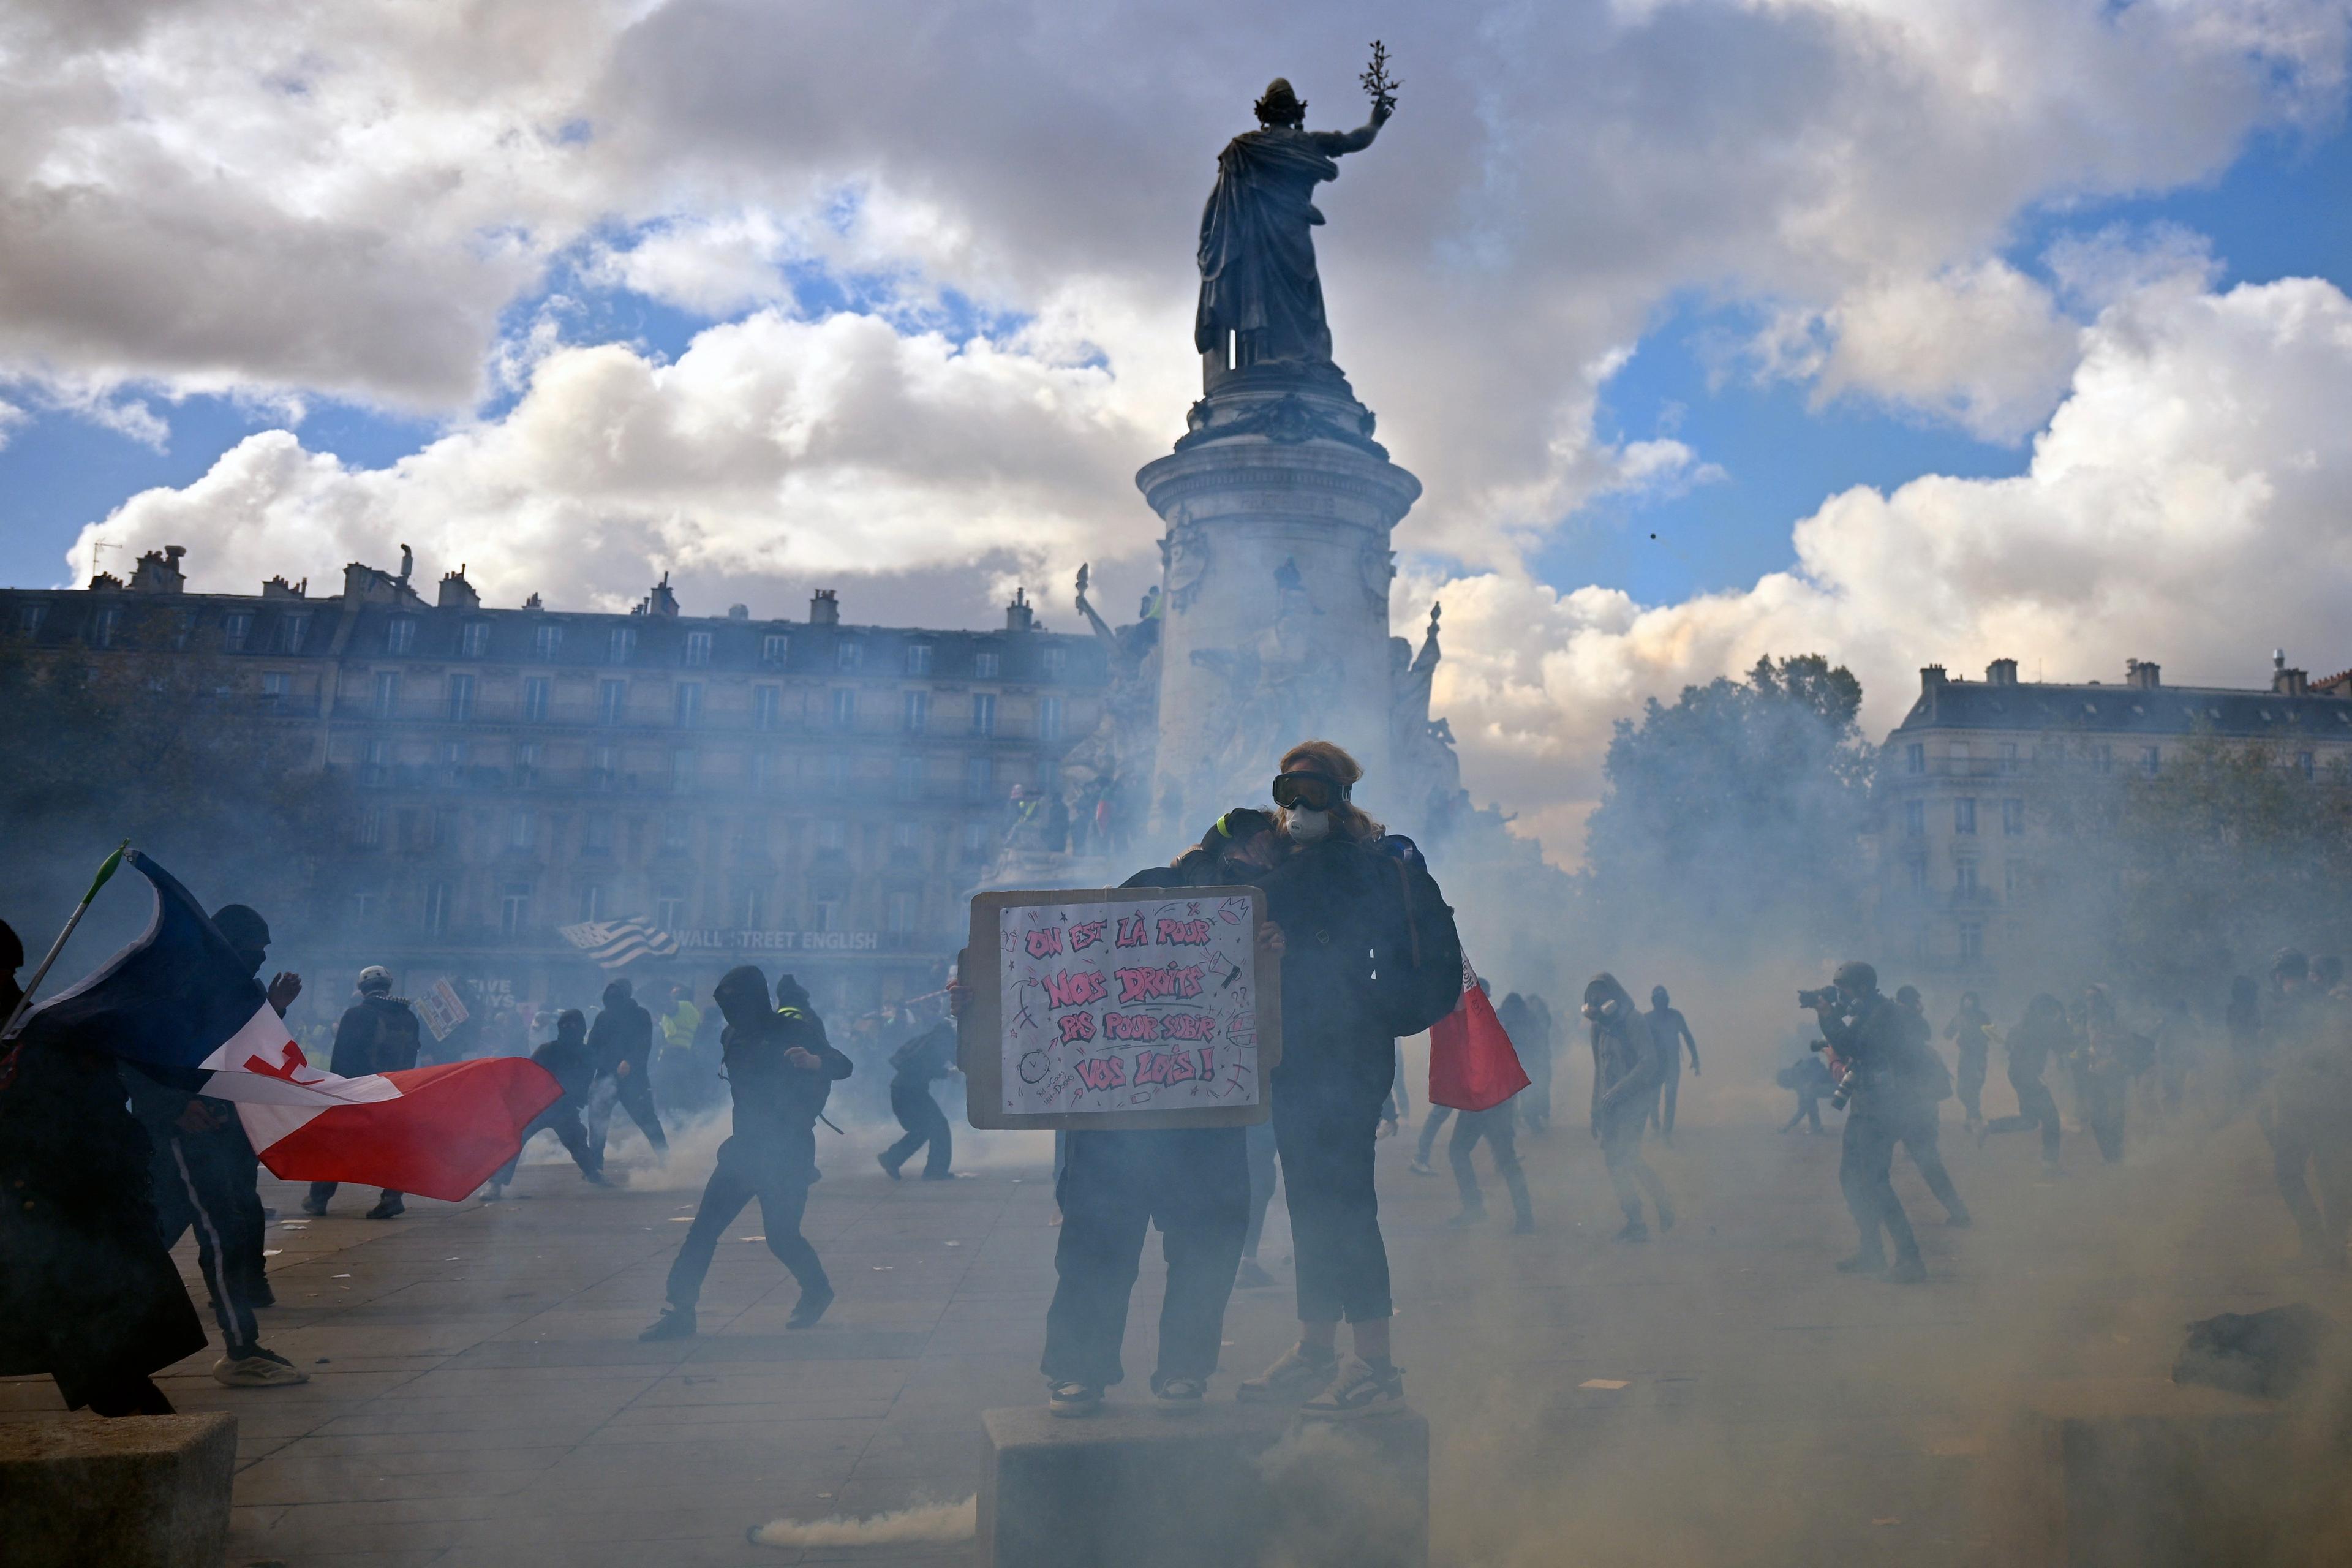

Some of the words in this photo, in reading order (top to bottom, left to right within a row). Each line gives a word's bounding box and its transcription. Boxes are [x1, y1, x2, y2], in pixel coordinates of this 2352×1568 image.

[674, 930, 723, 946] WALL
[802, 932, 878, 949] ENGLISH
[1025, 927, 1063, 960] ON
[1069, 919, 1107, 952] EST
[1115, 910, 1148, 949] LÀ
[1156, 918, 1211, 946] POUR
[1041, 968, 1108, 1011] NOS
[1114, 961, 1206, 1005] DROITS
[1057, 1011, 1097, 1047] PAS
[1103, 1012, 1159, 1043] POUR
[1160, 1013, 1216, 1044] SUBIR
[1073, 1055, 1126, 1092] VOS
